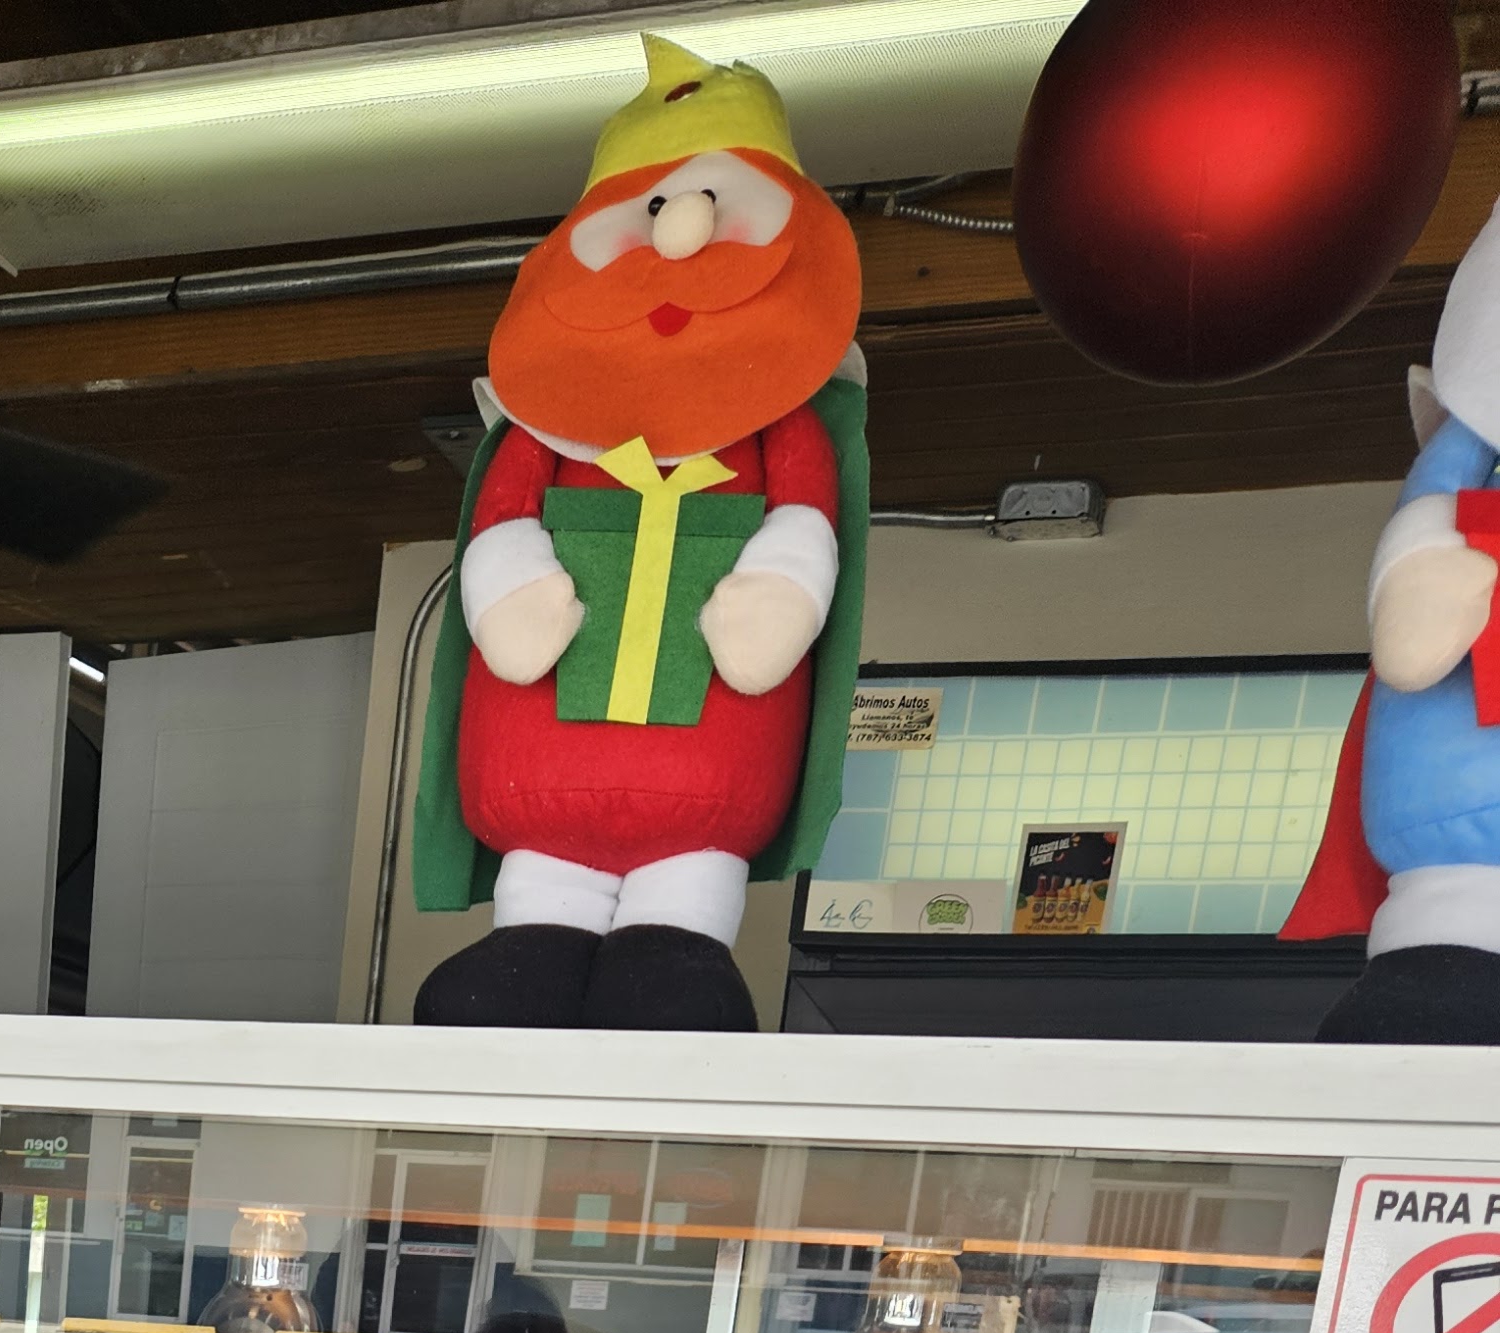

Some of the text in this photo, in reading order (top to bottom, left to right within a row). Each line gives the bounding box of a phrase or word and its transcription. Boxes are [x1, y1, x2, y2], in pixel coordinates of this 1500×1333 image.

[853, 694, 930, 709] Abrimos Autos
[1374, 1189, 1471, 1225] PARA
